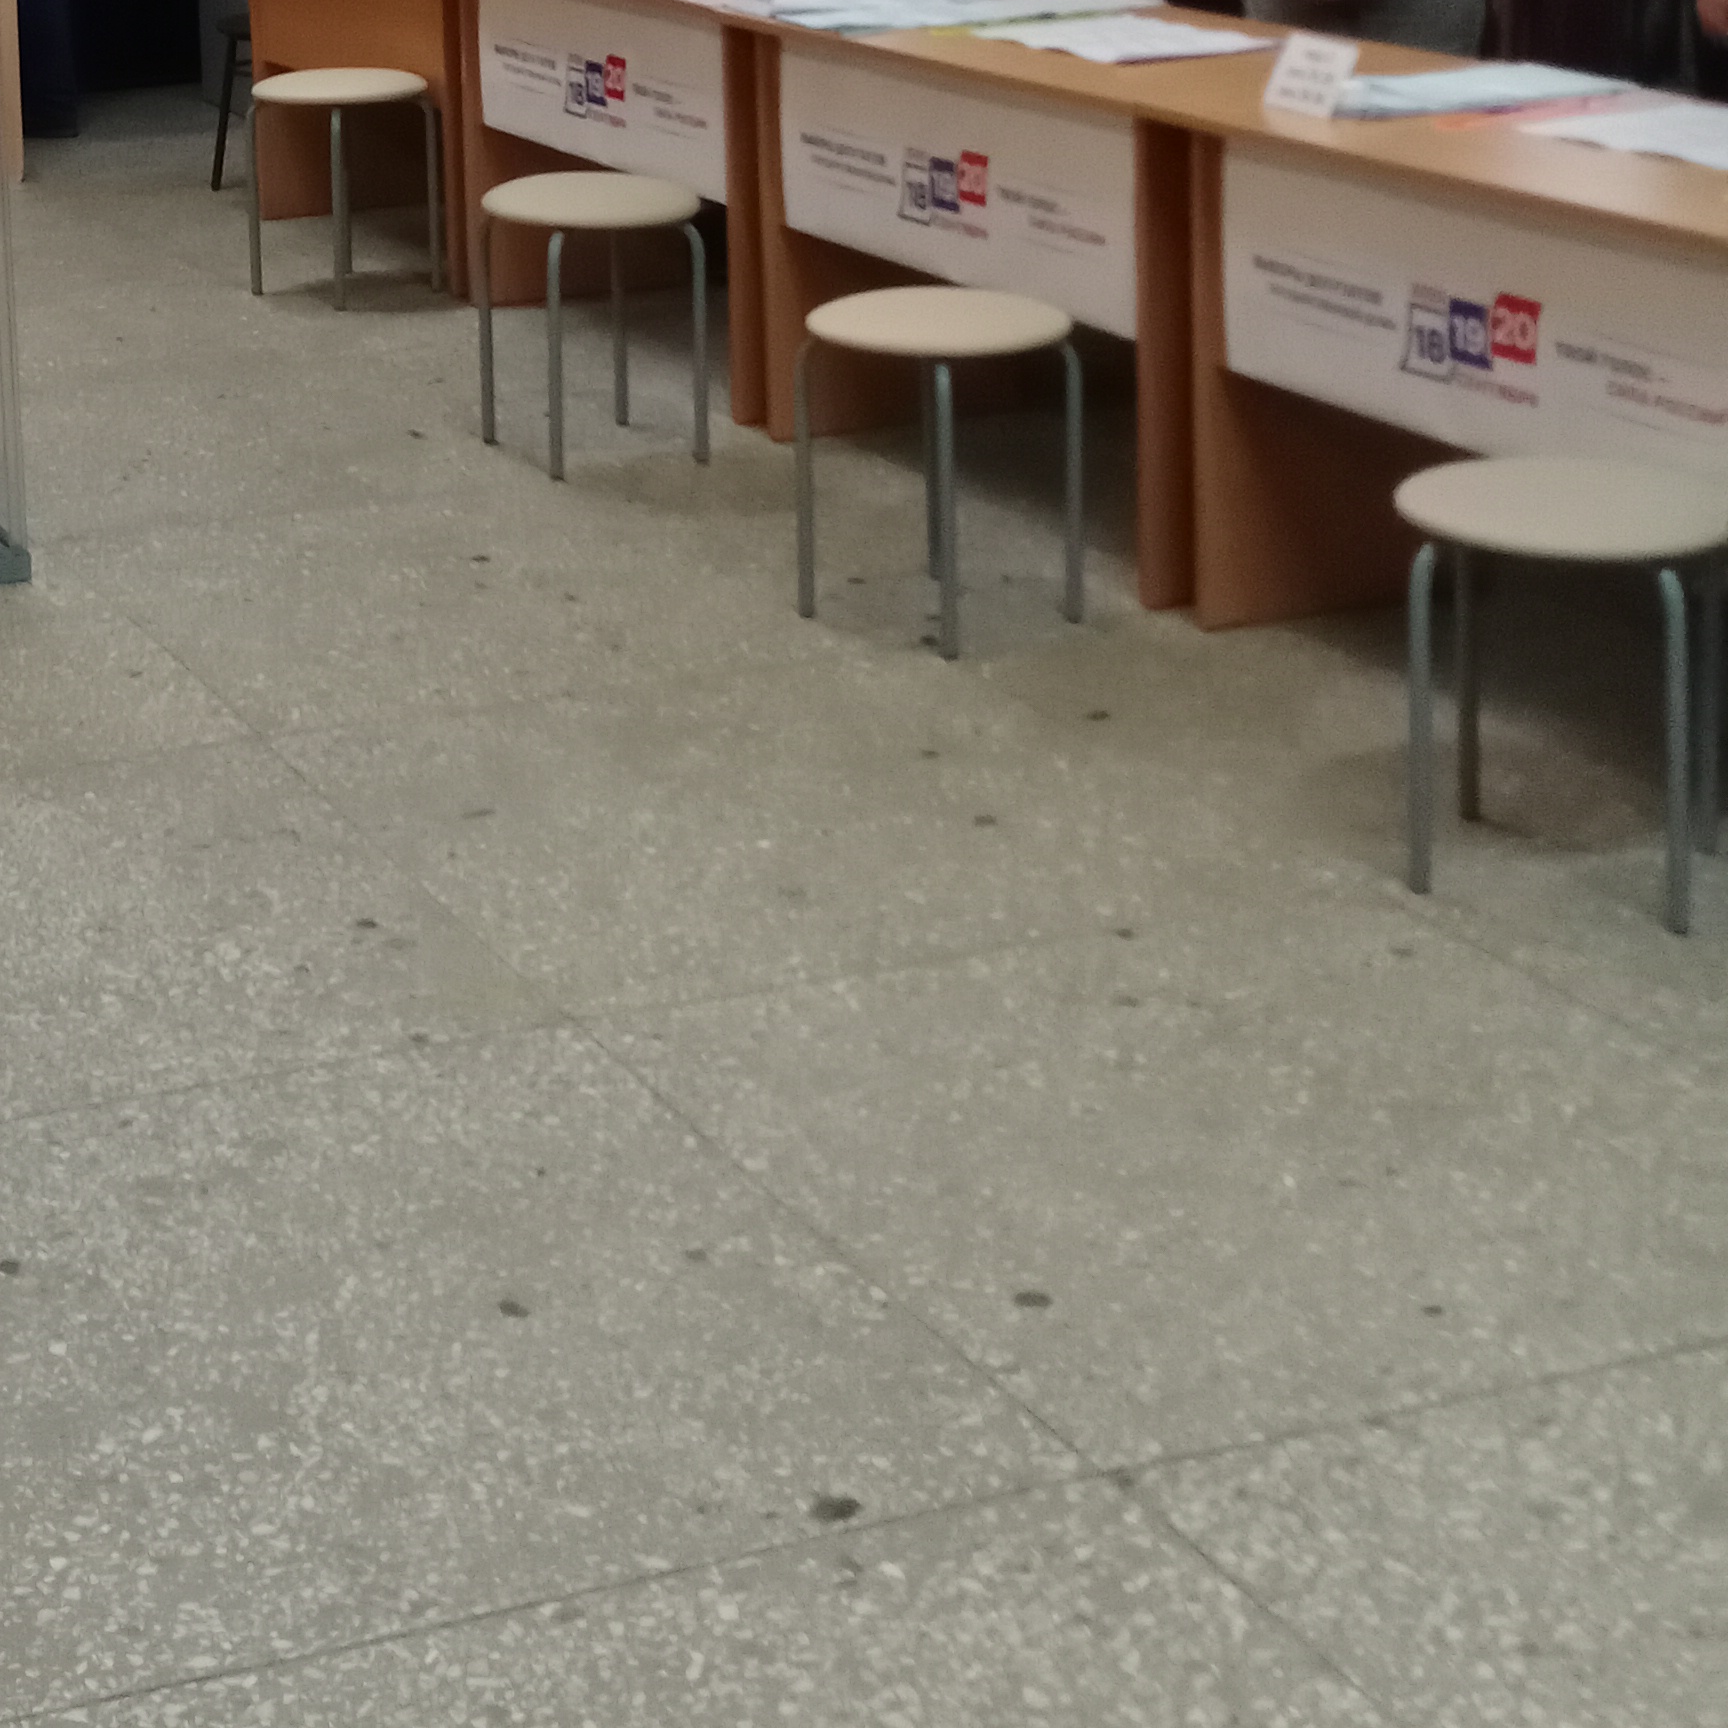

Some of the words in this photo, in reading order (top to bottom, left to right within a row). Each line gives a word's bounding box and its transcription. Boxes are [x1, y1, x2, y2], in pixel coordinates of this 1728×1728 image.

[1416, 325, 1446, 364] 18
[1452, 314, 1486, 356] 19
[1490, 307, 1538, 351] 20
